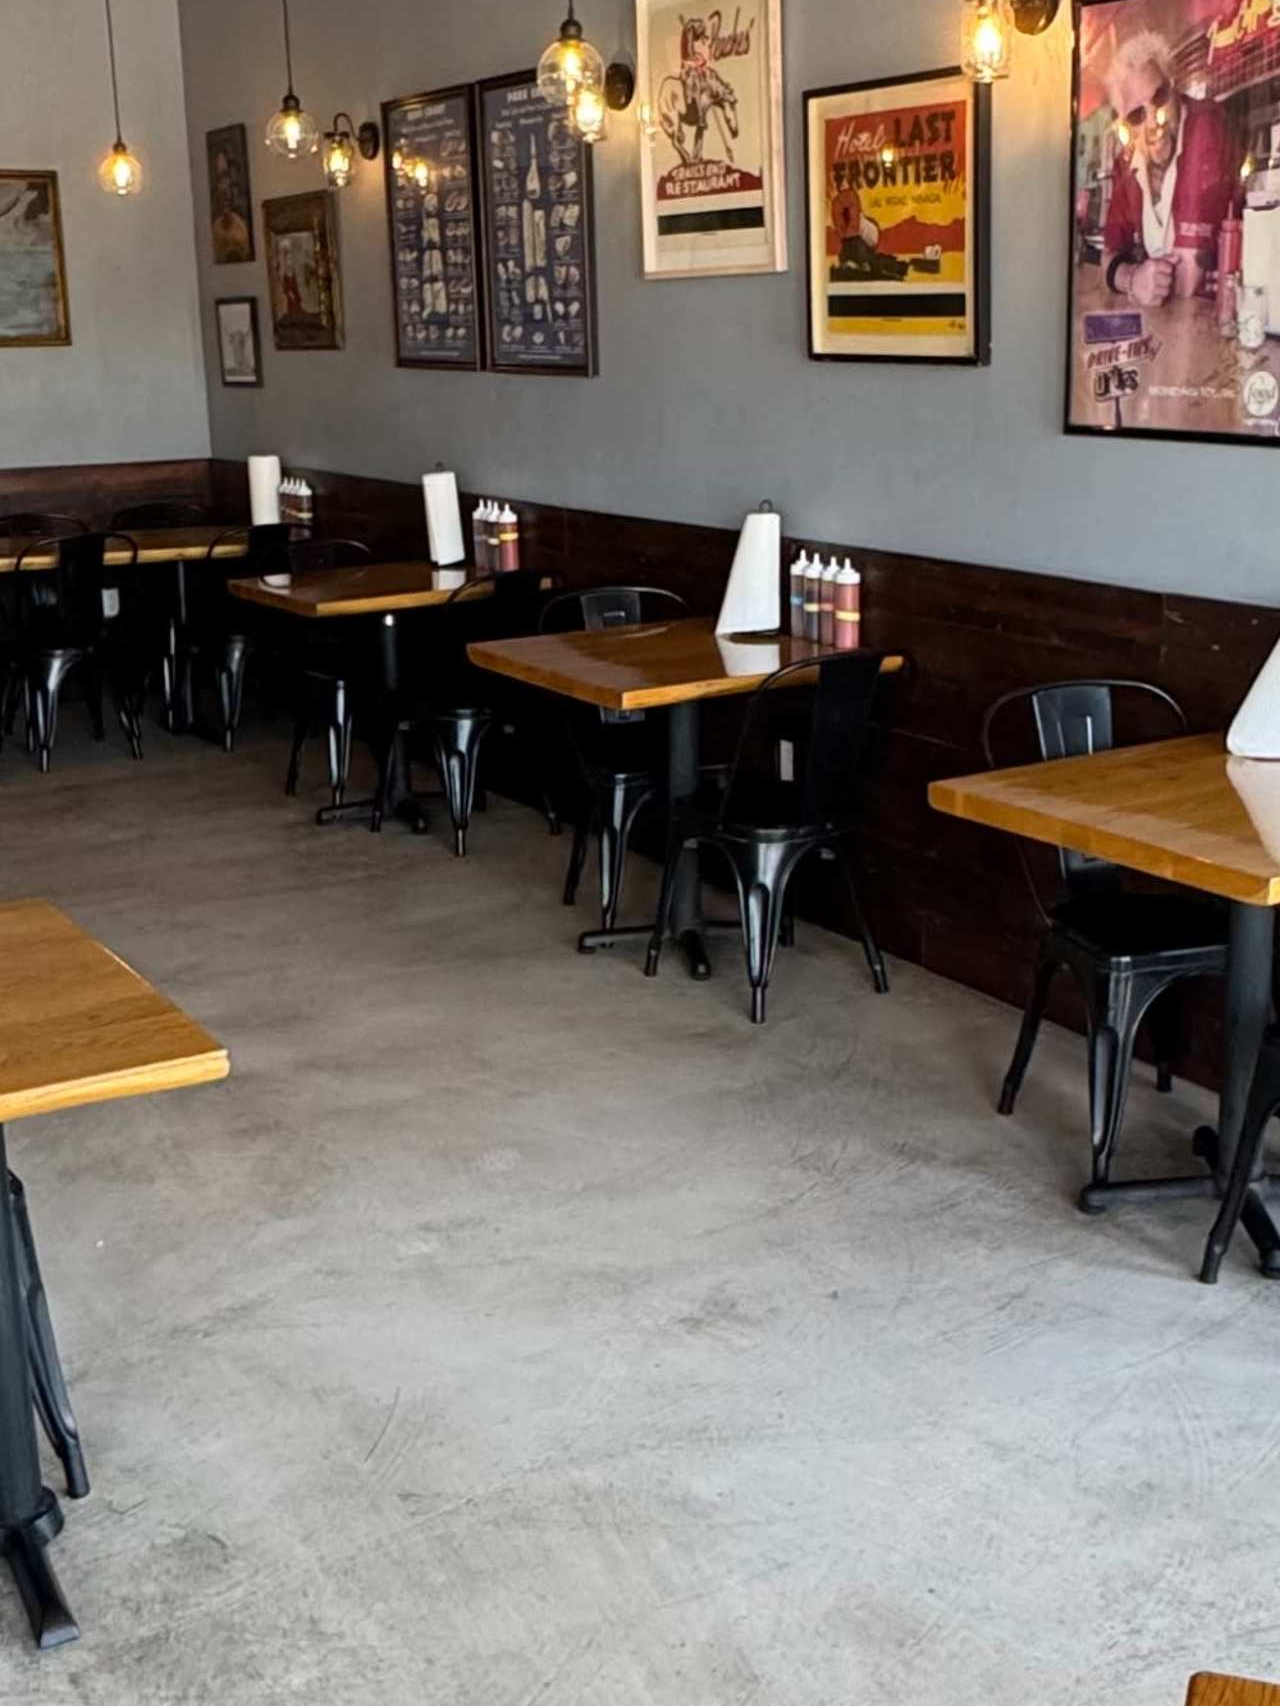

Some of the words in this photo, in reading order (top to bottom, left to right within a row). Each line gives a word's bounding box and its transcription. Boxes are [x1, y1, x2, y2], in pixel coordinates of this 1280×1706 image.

[834, 120, 887, 159] Hotel
[893, 109, 956, 150] LAST
[665, 172, 741, 197] RESTAURANT
[833, 150, 957, 193] FRONTIER
